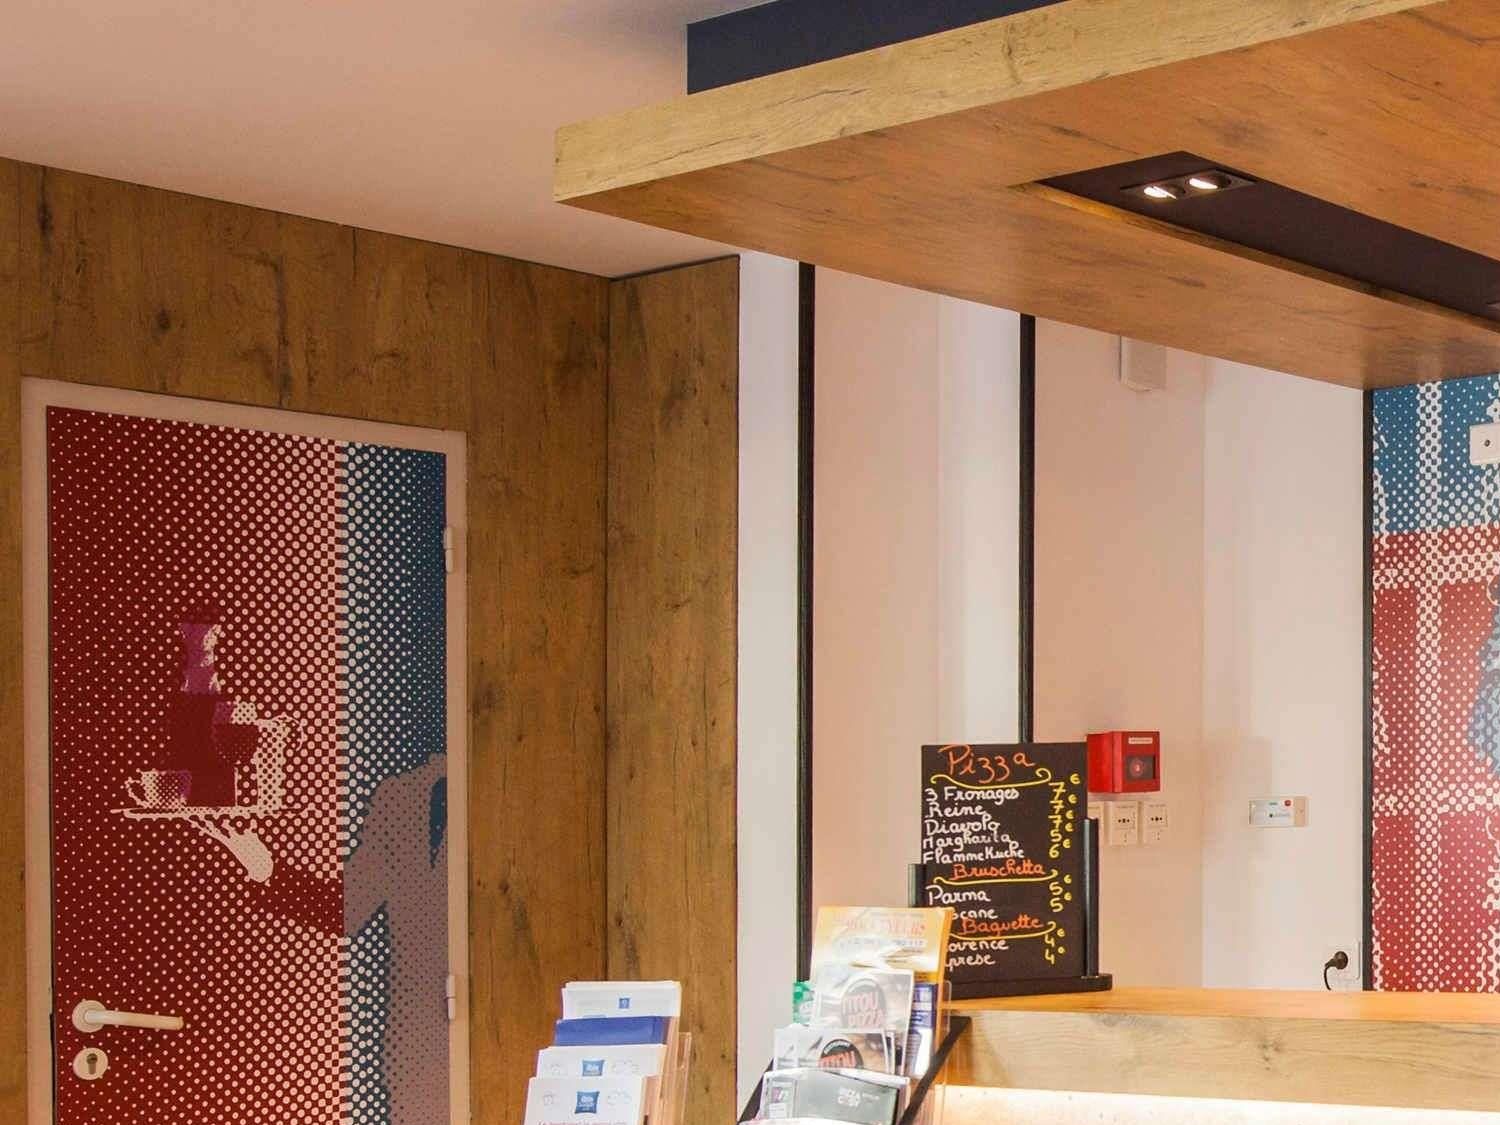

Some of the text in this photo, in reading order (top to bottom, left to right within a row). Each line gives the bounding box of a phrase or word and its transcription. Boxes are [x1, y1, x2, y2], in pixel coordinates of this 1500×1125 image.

[937, 744, 1036, 784] Pizza
[924, 788, 938, 802] 3
[925, 801, 989, 818] Reine
[949, 859, 1046, 880] Bruschetta
[926, 884, 991, 906] Parma
[951, 908, 999, 920] scane
[956, 913, 1044, 937] Baguette
[948, 939, 1009, 952] ovence
[945, 954, 996, 973] prese
